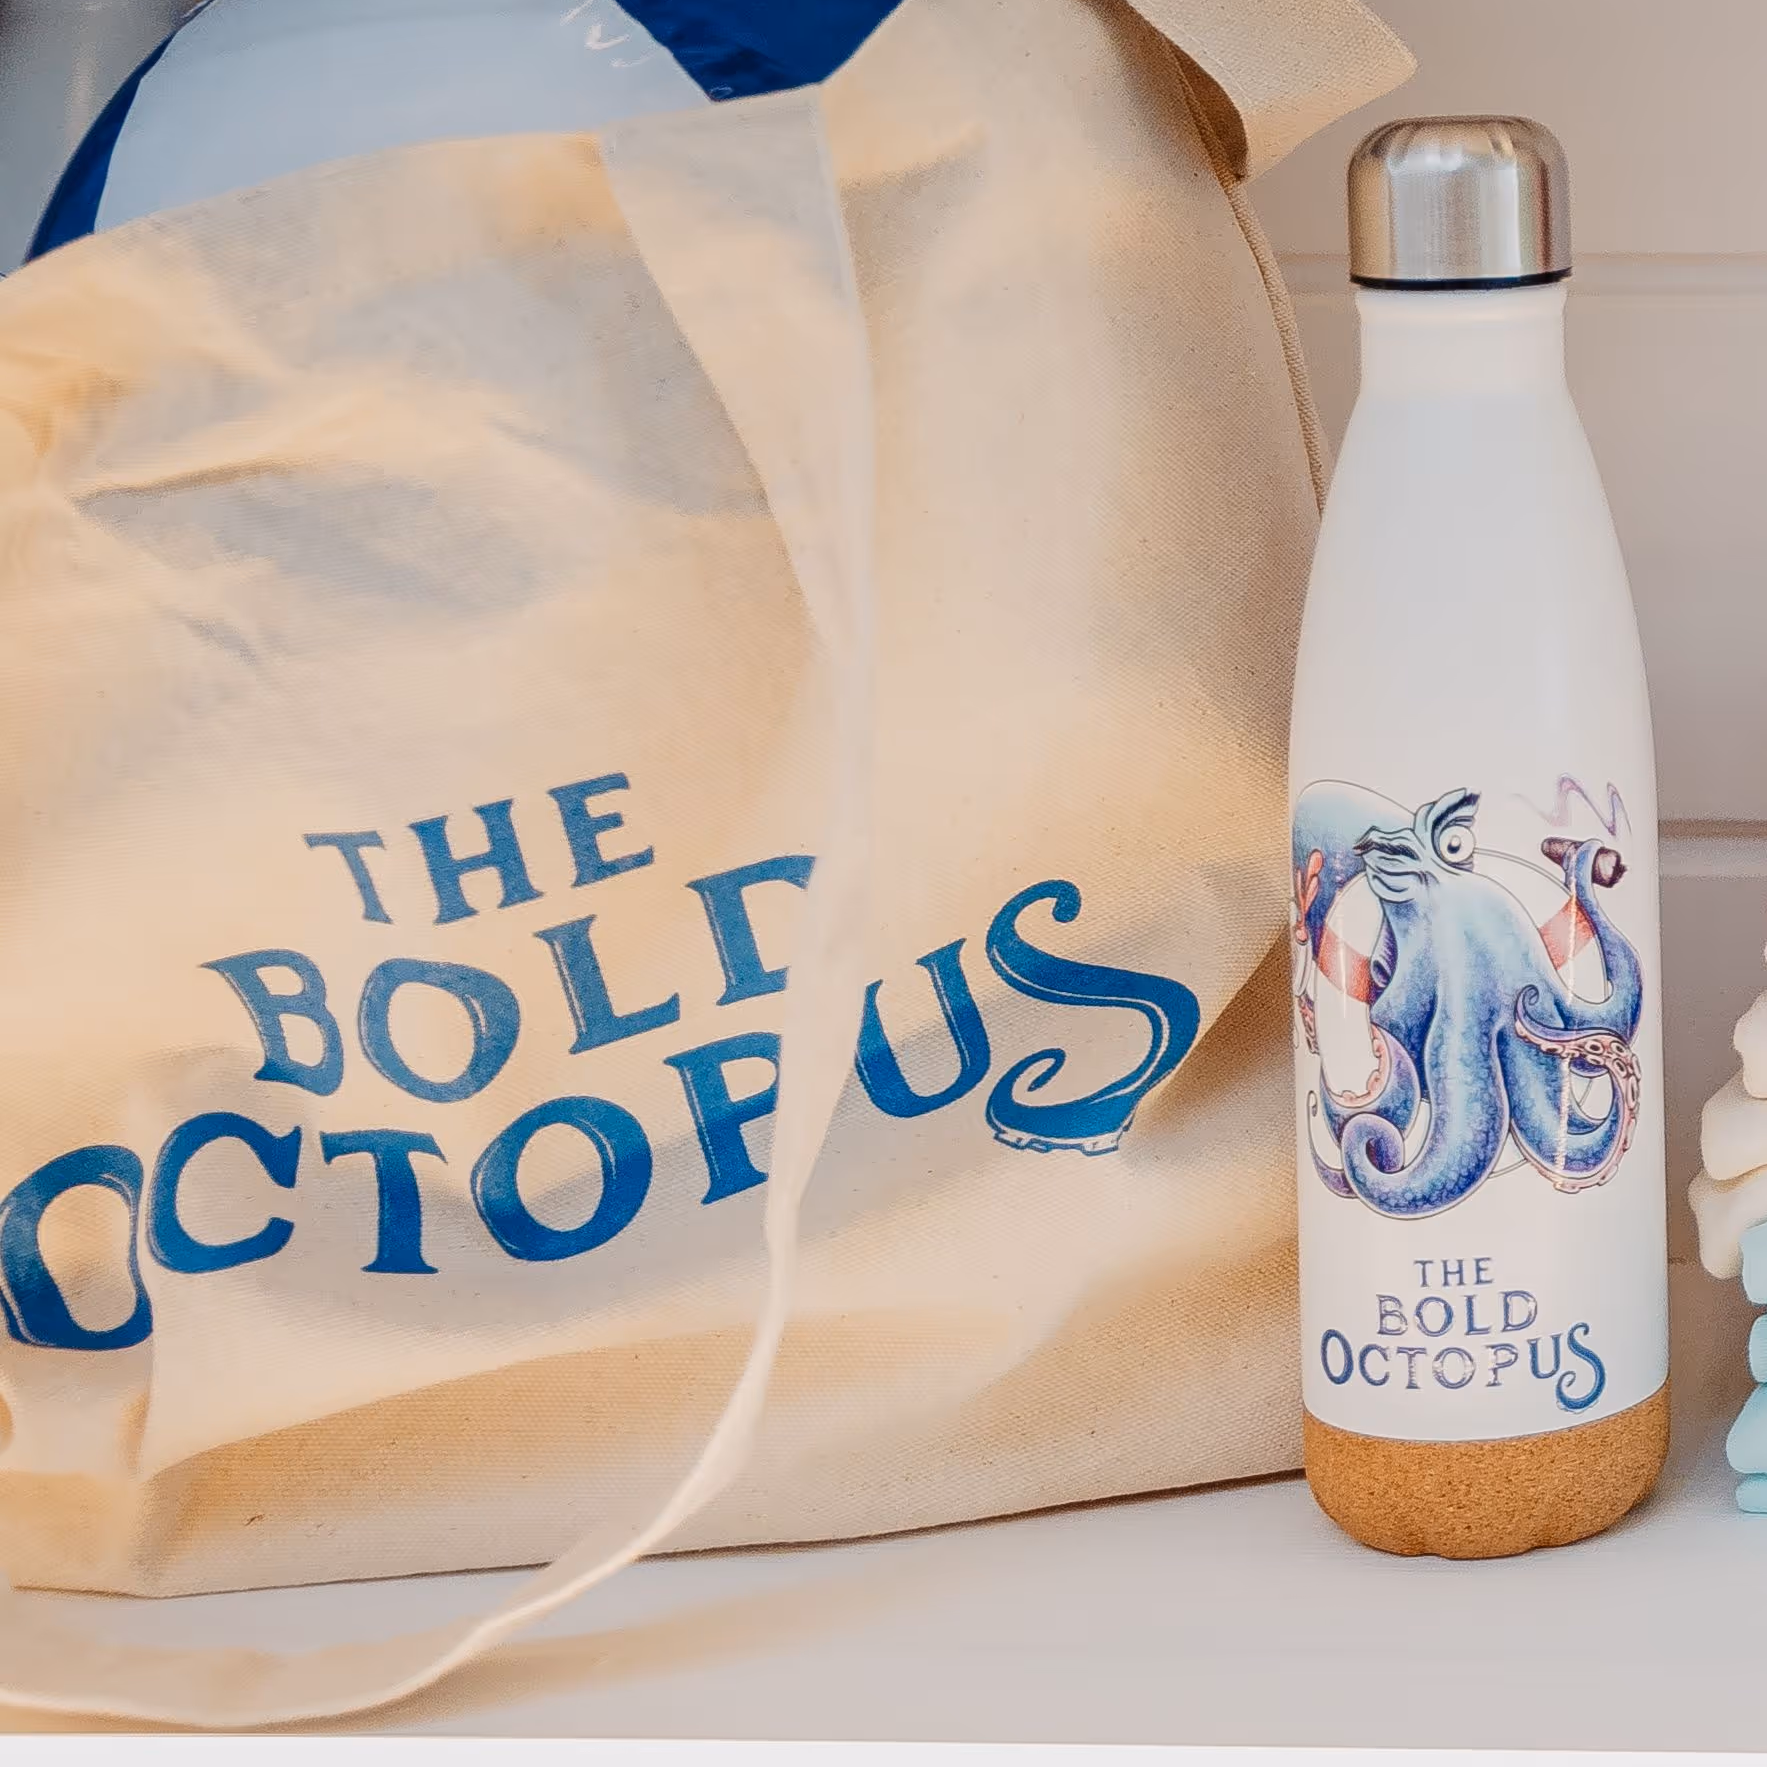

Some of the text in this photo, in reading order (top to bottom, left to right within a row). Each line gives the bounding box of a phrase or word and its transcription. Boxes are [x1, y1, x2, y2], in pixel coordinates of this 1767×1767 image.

[303, 772, 655, 927] THE
[0, 879, 1201, 1352] OCTOPUS
[1376, 1289, 1538, 1337] BOLD
[1414, 1256, 1494, 1288] THE
[1320, 1321, 1606, 1414] OCTOPUS
